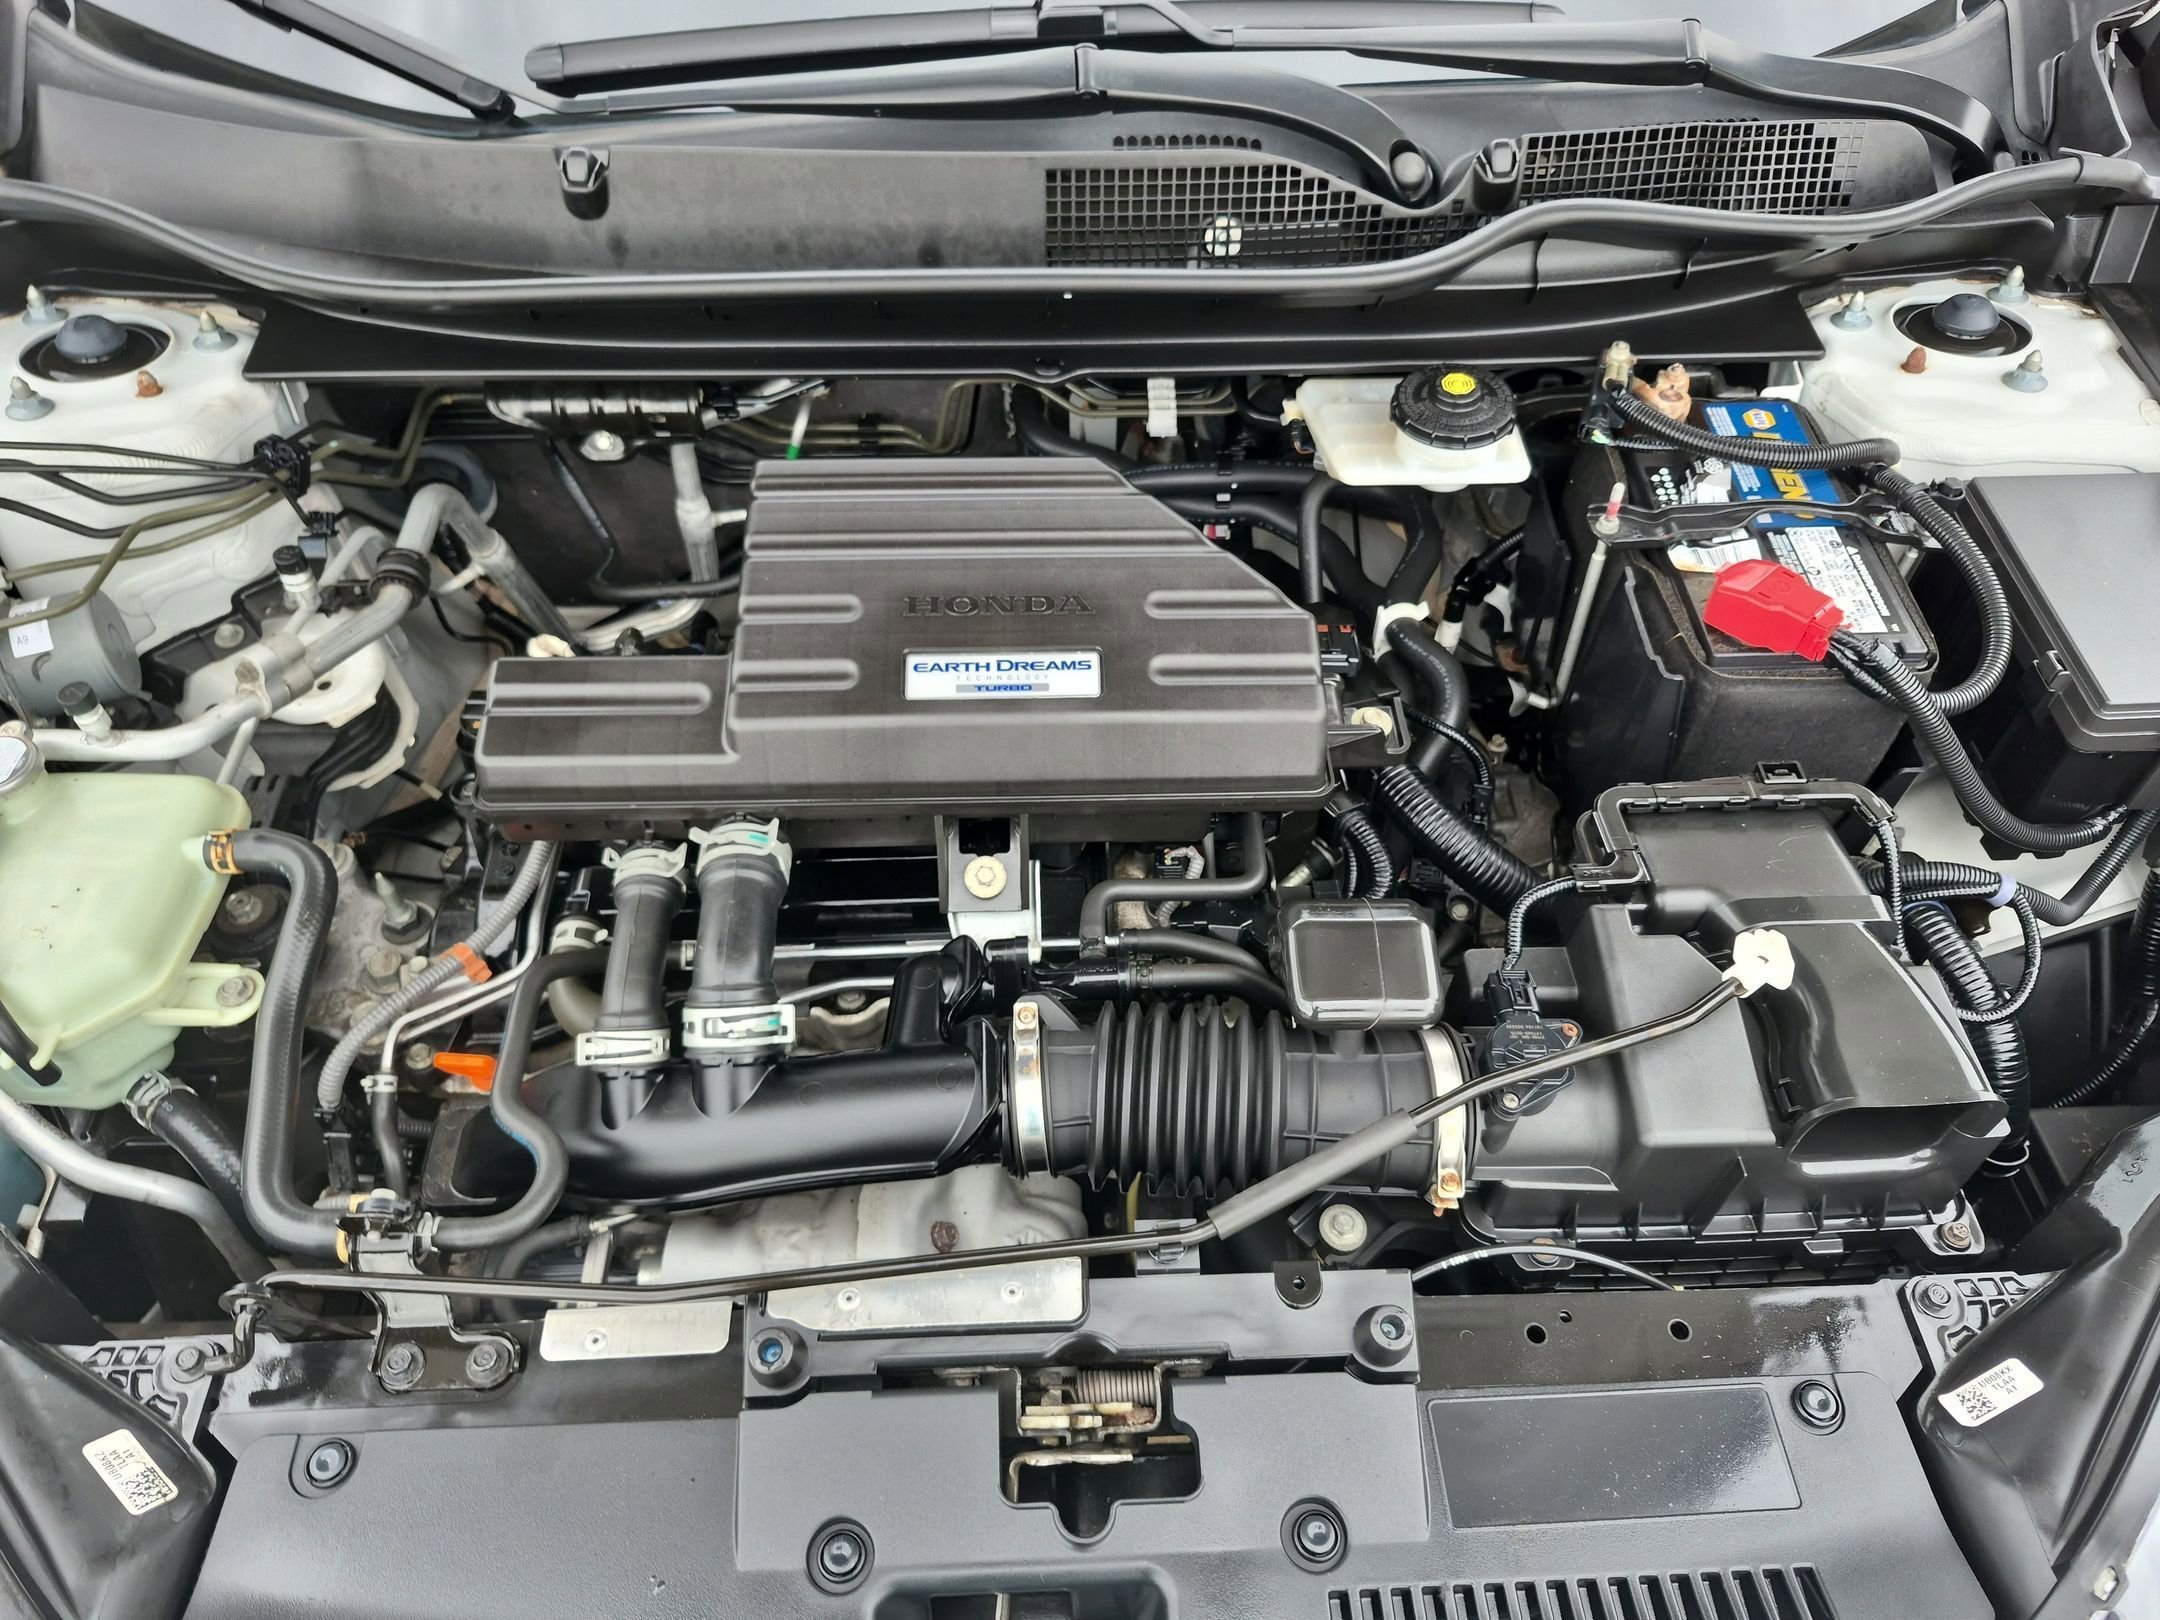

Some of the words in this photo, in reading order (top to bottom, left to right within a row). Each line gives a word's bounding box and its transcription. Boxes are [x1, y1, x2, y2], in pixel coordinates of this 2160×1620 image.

[903, 594, 1096, 617] HONDA
[16, 634, 29, 647] A9
[913, 661, 991, 673] EARTH
[996, 659, 1092, 672] DREAMS
[1978, 1365, 2014, 1389] UB08KX
[1991, 1375, 2016, 1391] TLAA
[2006, 1385, 2018, 1395] A1
[108, 1449, 129, 1470] TLAA
[122, 1448, 136, 1459] A1
